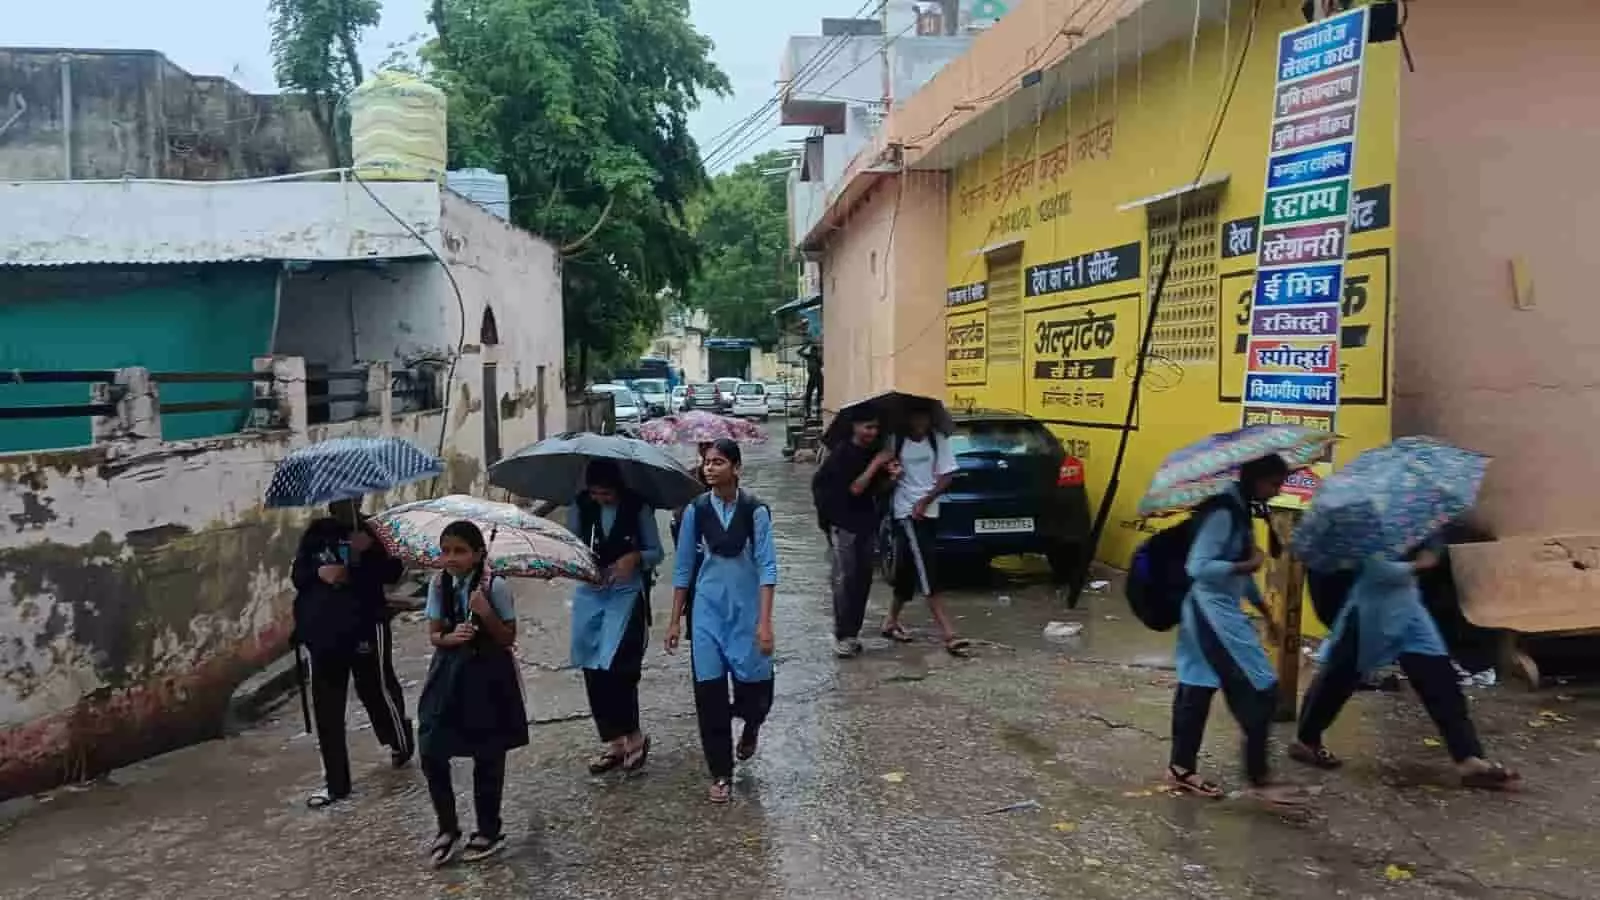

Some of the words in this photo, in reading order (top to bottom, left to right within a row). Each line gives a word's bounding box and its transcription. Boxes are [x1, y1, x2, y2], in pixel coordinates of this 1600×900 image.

[1282, 53, 1320, 78] लेखन
[1323, 37, 1357, 65] कार्य
[1272, 186, 1342, 219] स्टाम्प
[1229, 222, 1254, 256] देश
[1264, 228, 1341, 262] स्टेशनरी
[1032, 266, 1048, 295] देश
[1088, 251, 1119, 283] सीमेंट
[1263, 272, 1283, 301] ई
[1287, 271, 1336, 298] मित्र
[1035, 309, 1117, 358] अल्ट्राटेक
[1261, 311, 1331, 333] रजिस्ट्री
[1250, 379, 1300, 400] विभागीय
[1303, 381, 1333, 401] फार्म
